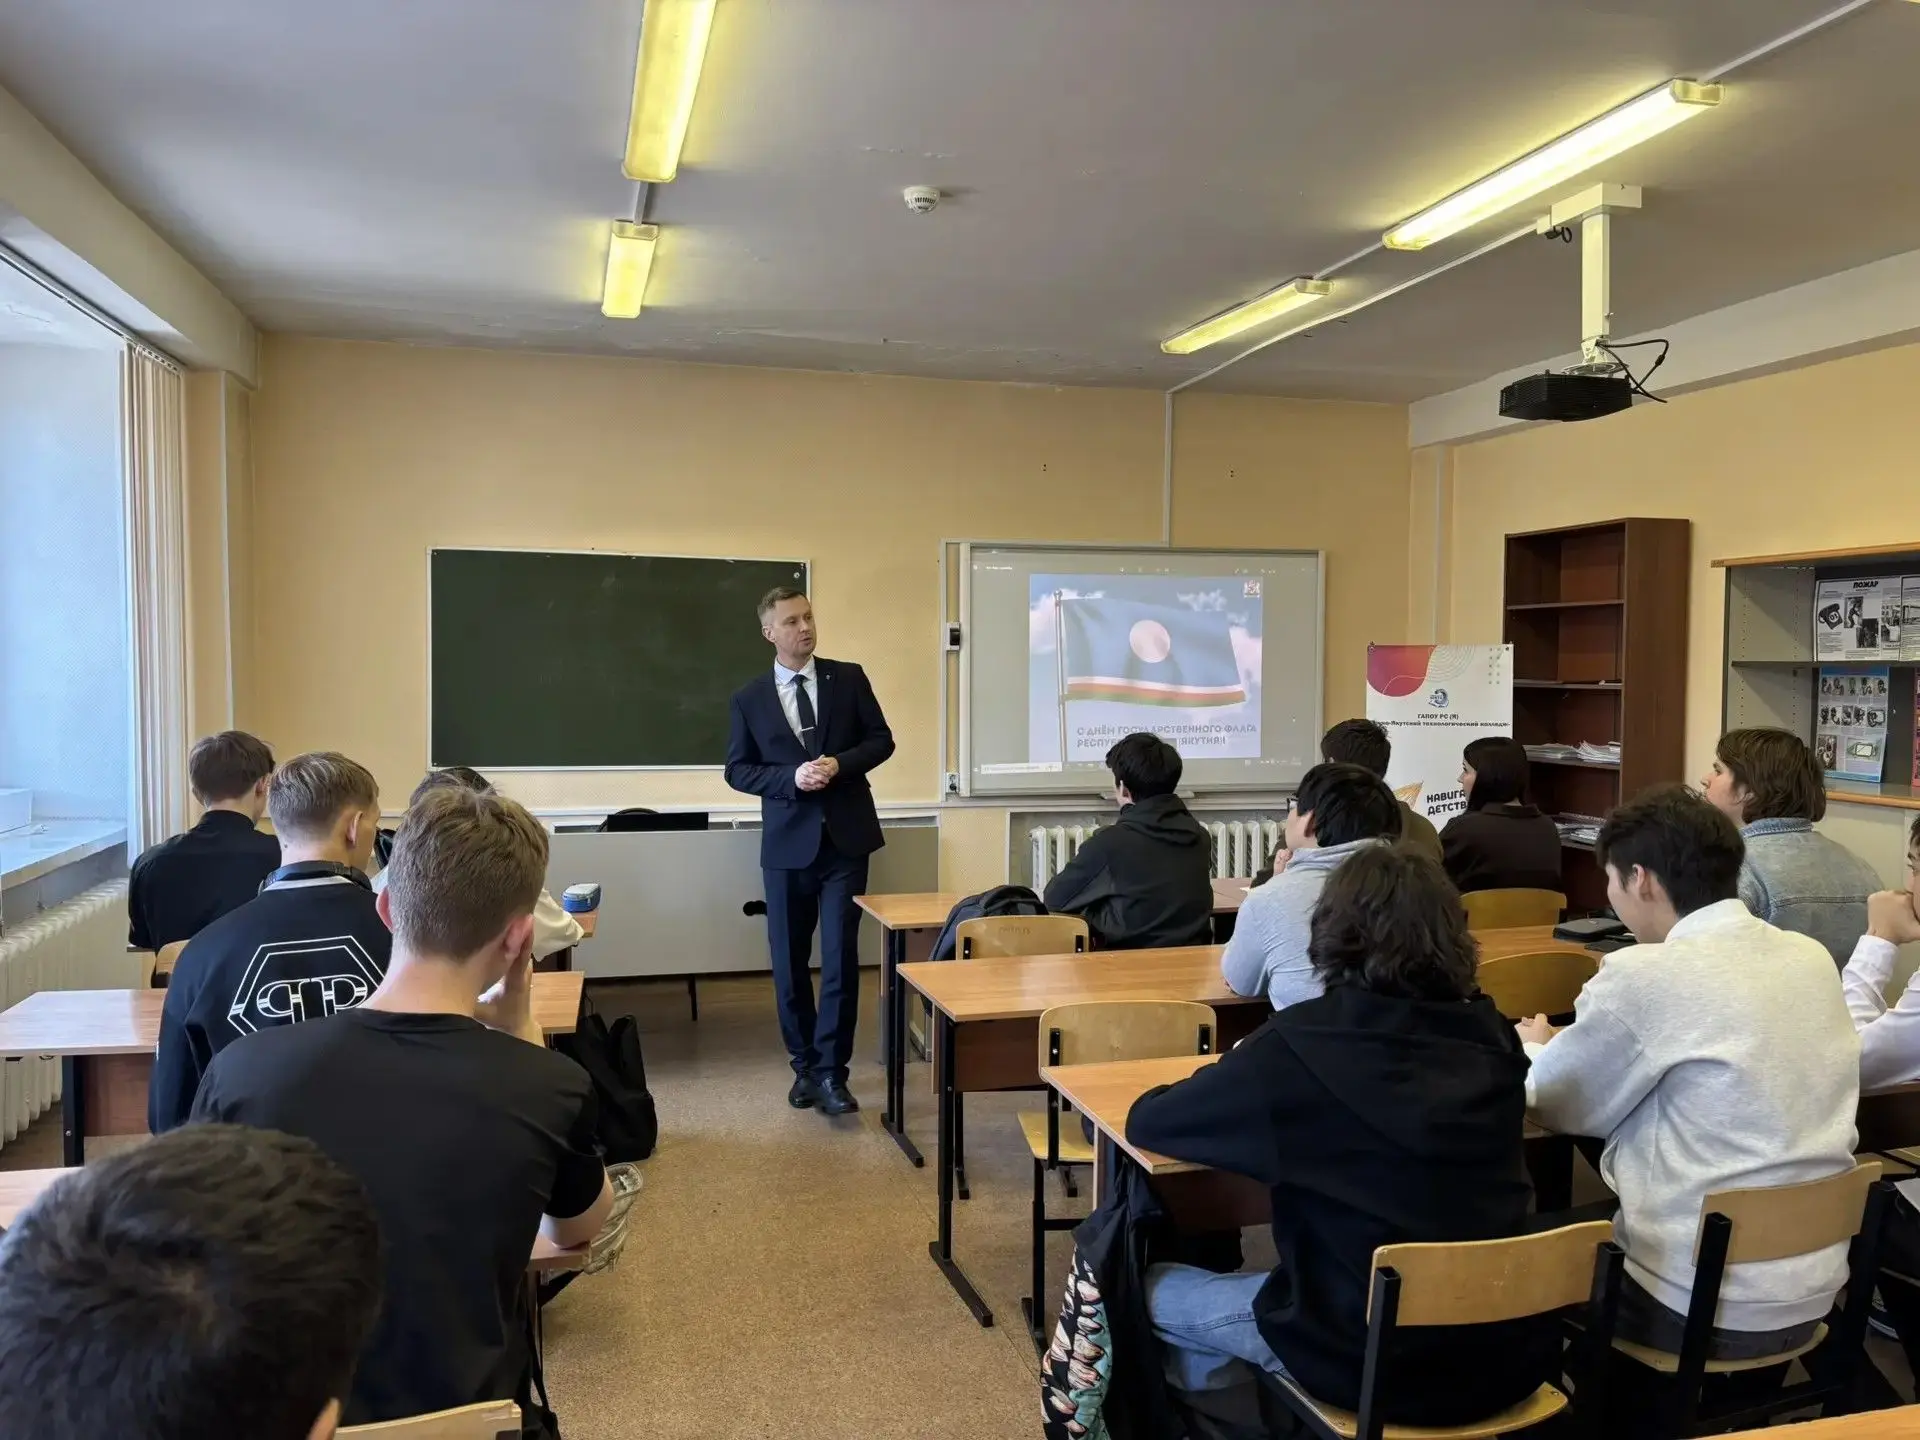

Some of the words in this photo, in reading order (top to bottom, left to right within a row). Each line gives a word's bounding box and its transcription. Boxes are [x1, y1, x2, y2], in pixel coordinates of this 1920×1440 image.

[1829, 611, 1839, 620] 01
[1077, 727, 1084, 736] С
[1086, 724, 1115, 736] ДНЁМ
[1224, 724, 1257, 733] ФЛАГА
[1426, 789, 1466, 803] НАВИГА
[1427, 801, 1468, 816] ДЕТСТВ
